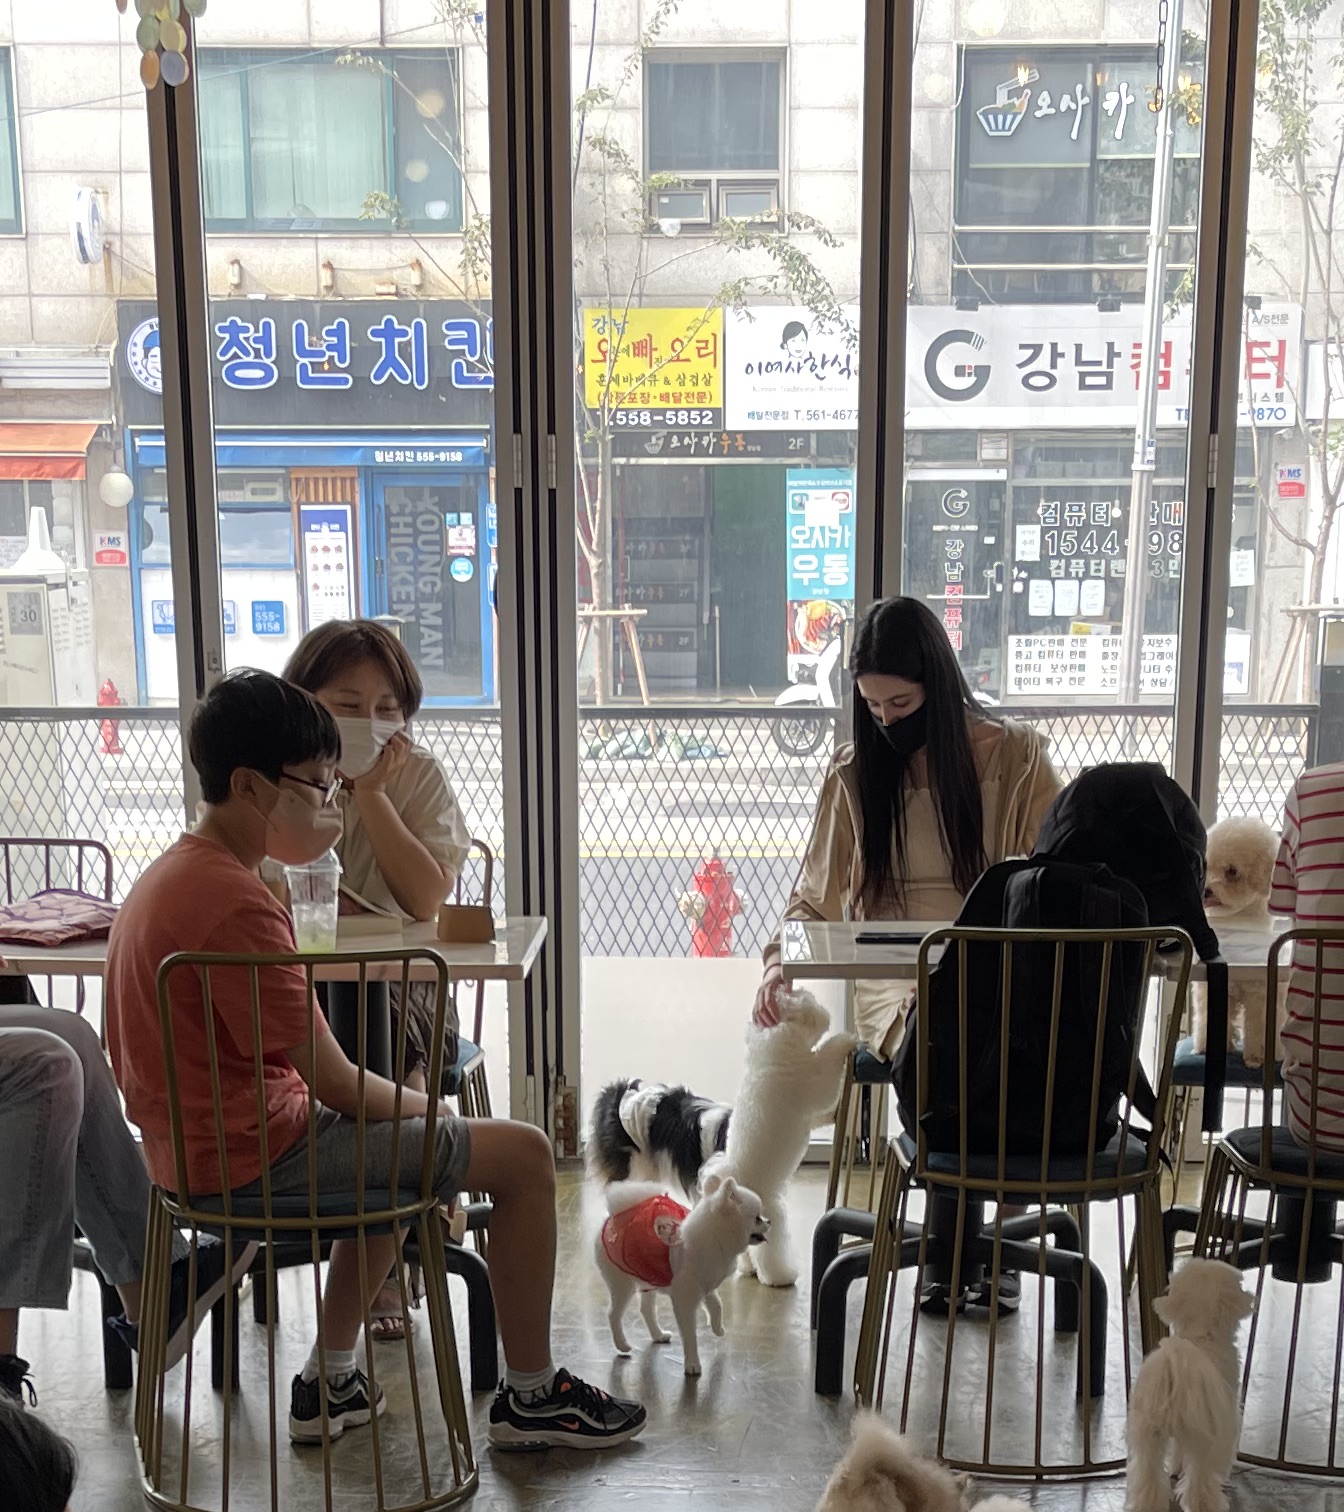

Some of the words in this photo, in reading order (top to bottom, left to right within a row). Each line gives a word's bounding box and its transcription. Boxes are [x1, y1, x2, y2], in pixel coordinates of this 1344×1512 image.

[215, 314, 494, 390] 청년치킨
[1016, 340, 1286, 391] 강남컴터
[788, 437, 805, 450] 2F
[1040, 501, 1112, 527] 컴퓨터
[790, 524, 851, 549] 오사카
[792, 553, 850, 587] 우동
[20, 609, 37, 622] 30
[419, 602, 444, 666] MAN
